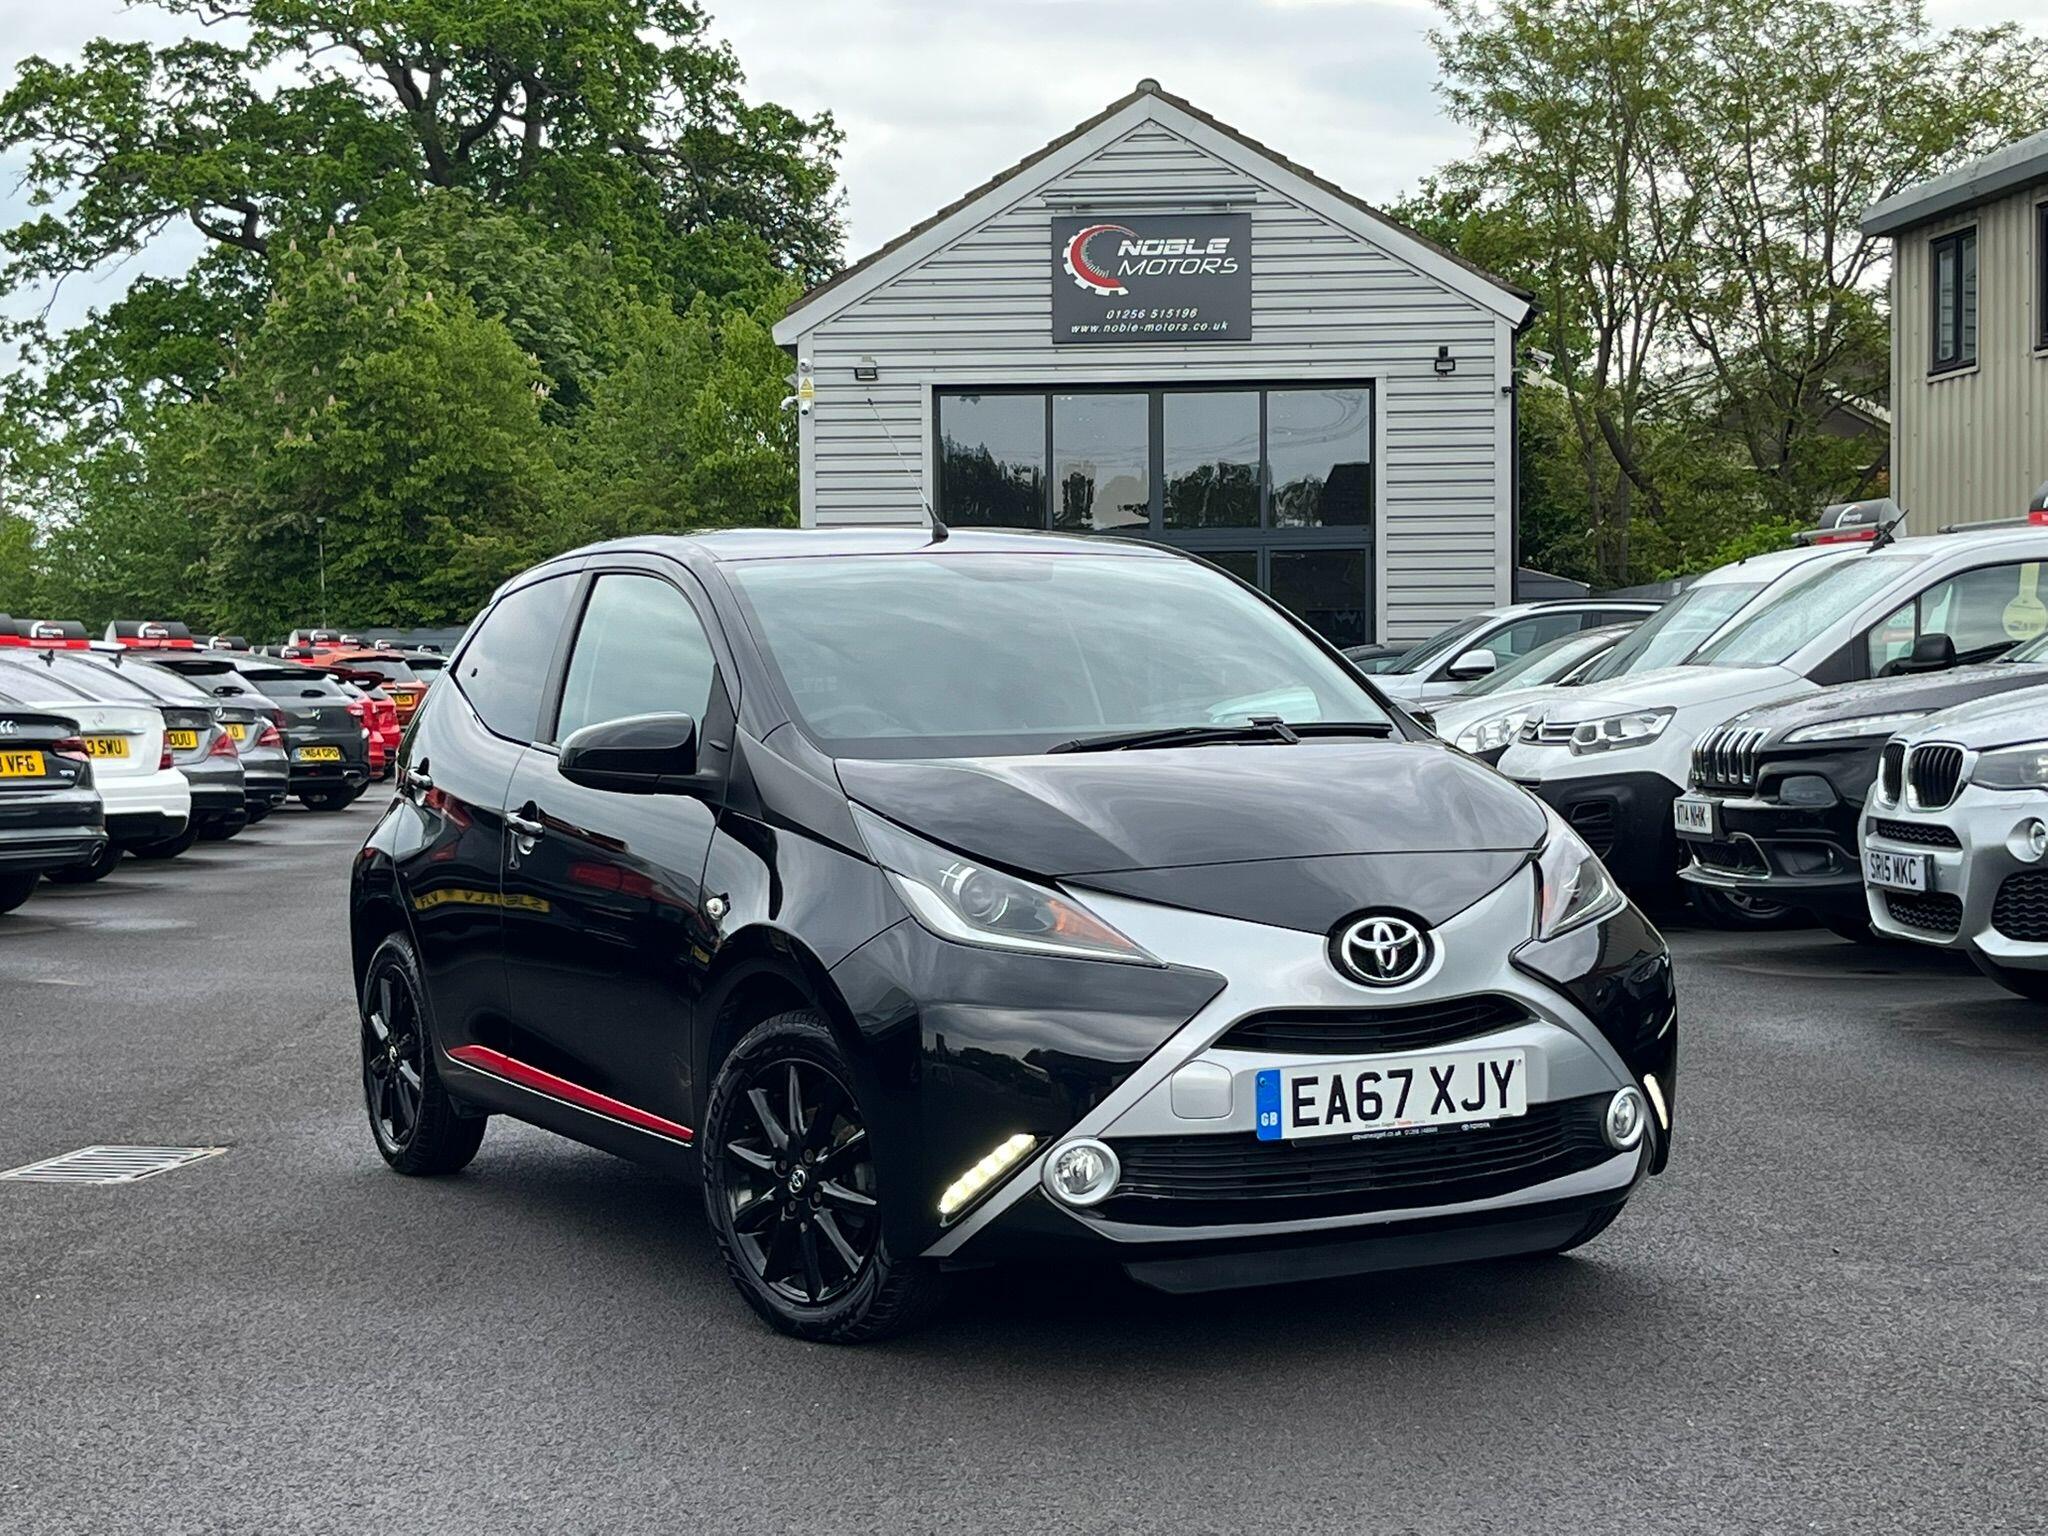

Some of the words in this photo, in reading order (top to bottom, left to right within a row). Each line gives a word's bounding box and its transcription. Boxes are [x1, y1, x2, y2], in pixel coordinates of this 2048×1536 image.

[1117, 238, 1230, 256] NOBLE
[1117, 257, 1239, 276] MOTORS
[1106, 309, 1146, 319] 01256
[1150, 308, 1199, 318] 515196
[1071, 320, 1229, 333] www.noble-motors.co.uk
[98, 740, 122, 755] SWU
[6, 755, 36, 773] VFG
[1291, 1068, 1413, 1128] EA67
[1429, 1059, 1515, 1115] XJY
[1260, 1112, 1278, 1126] GB
